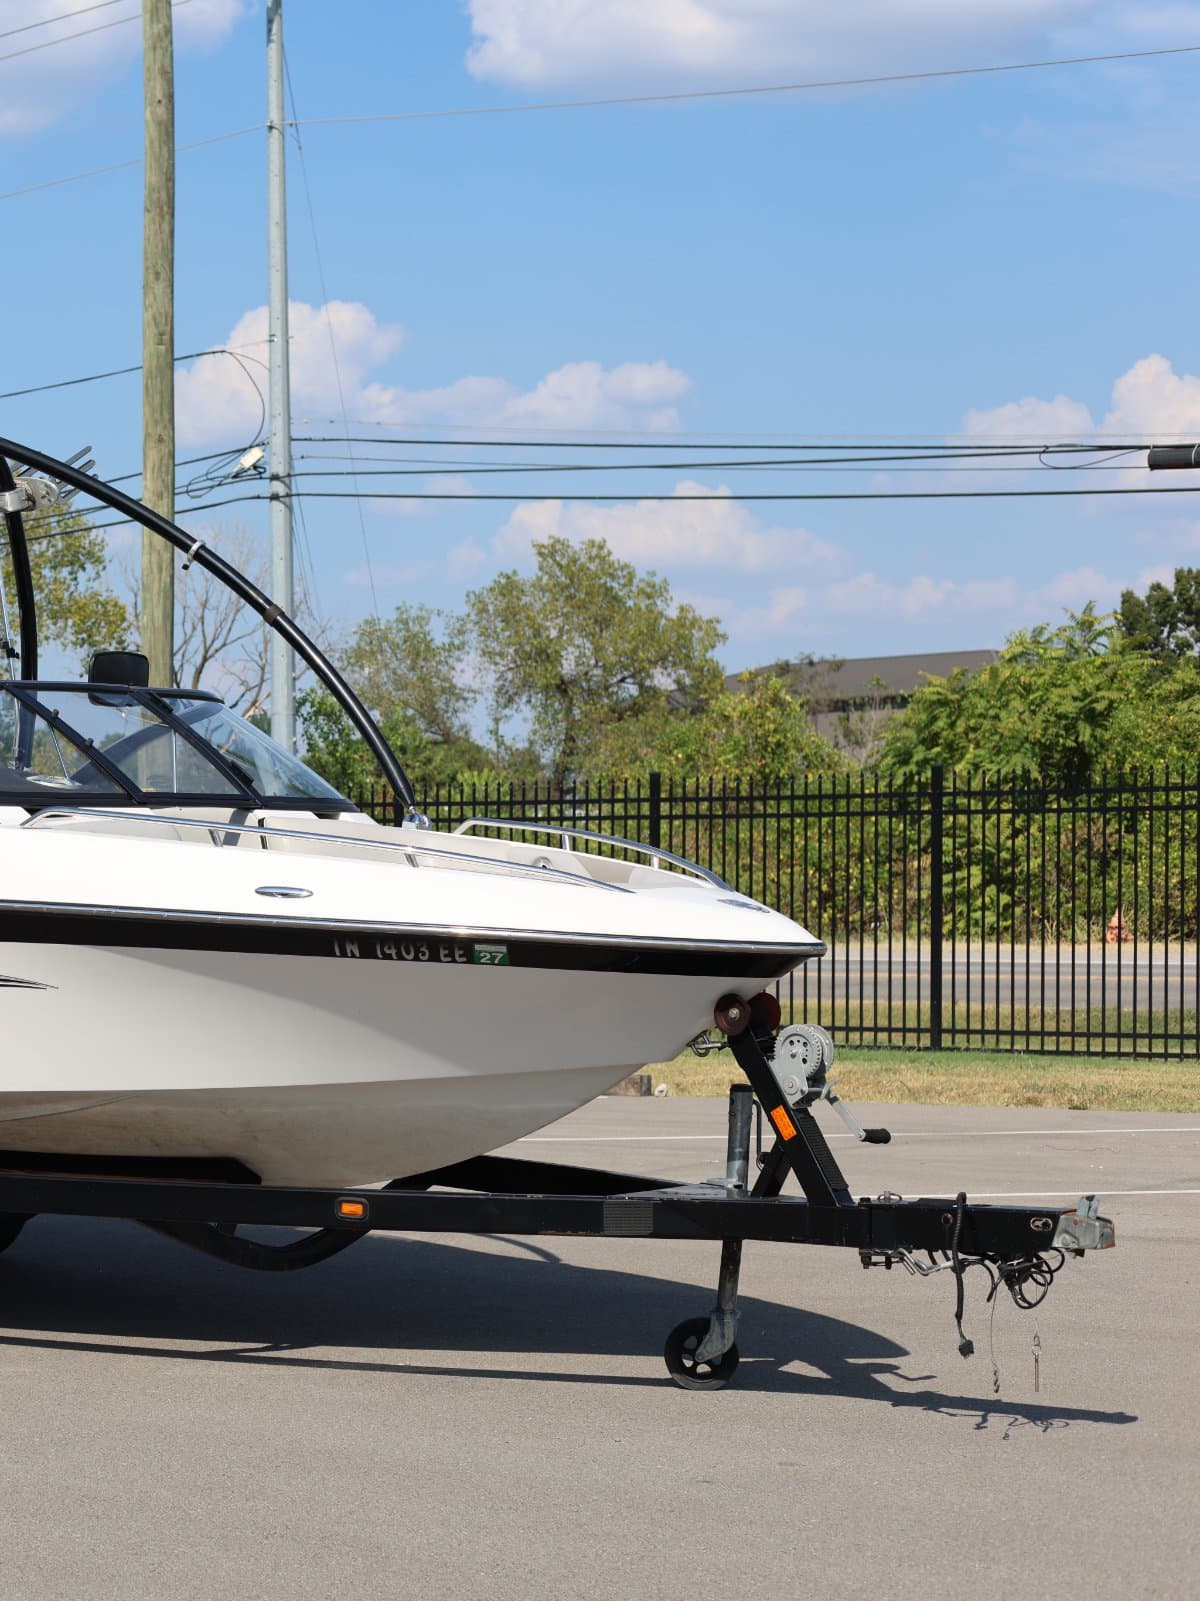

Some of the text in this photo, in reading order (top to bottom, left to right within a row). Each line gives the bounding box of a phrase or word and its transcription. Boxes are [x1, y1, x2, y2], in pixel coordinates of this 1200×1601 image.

[376, 941, 429, 961] 1403
[439, 943, 467, 962] EE
[479, 952, 504, 964] 27
